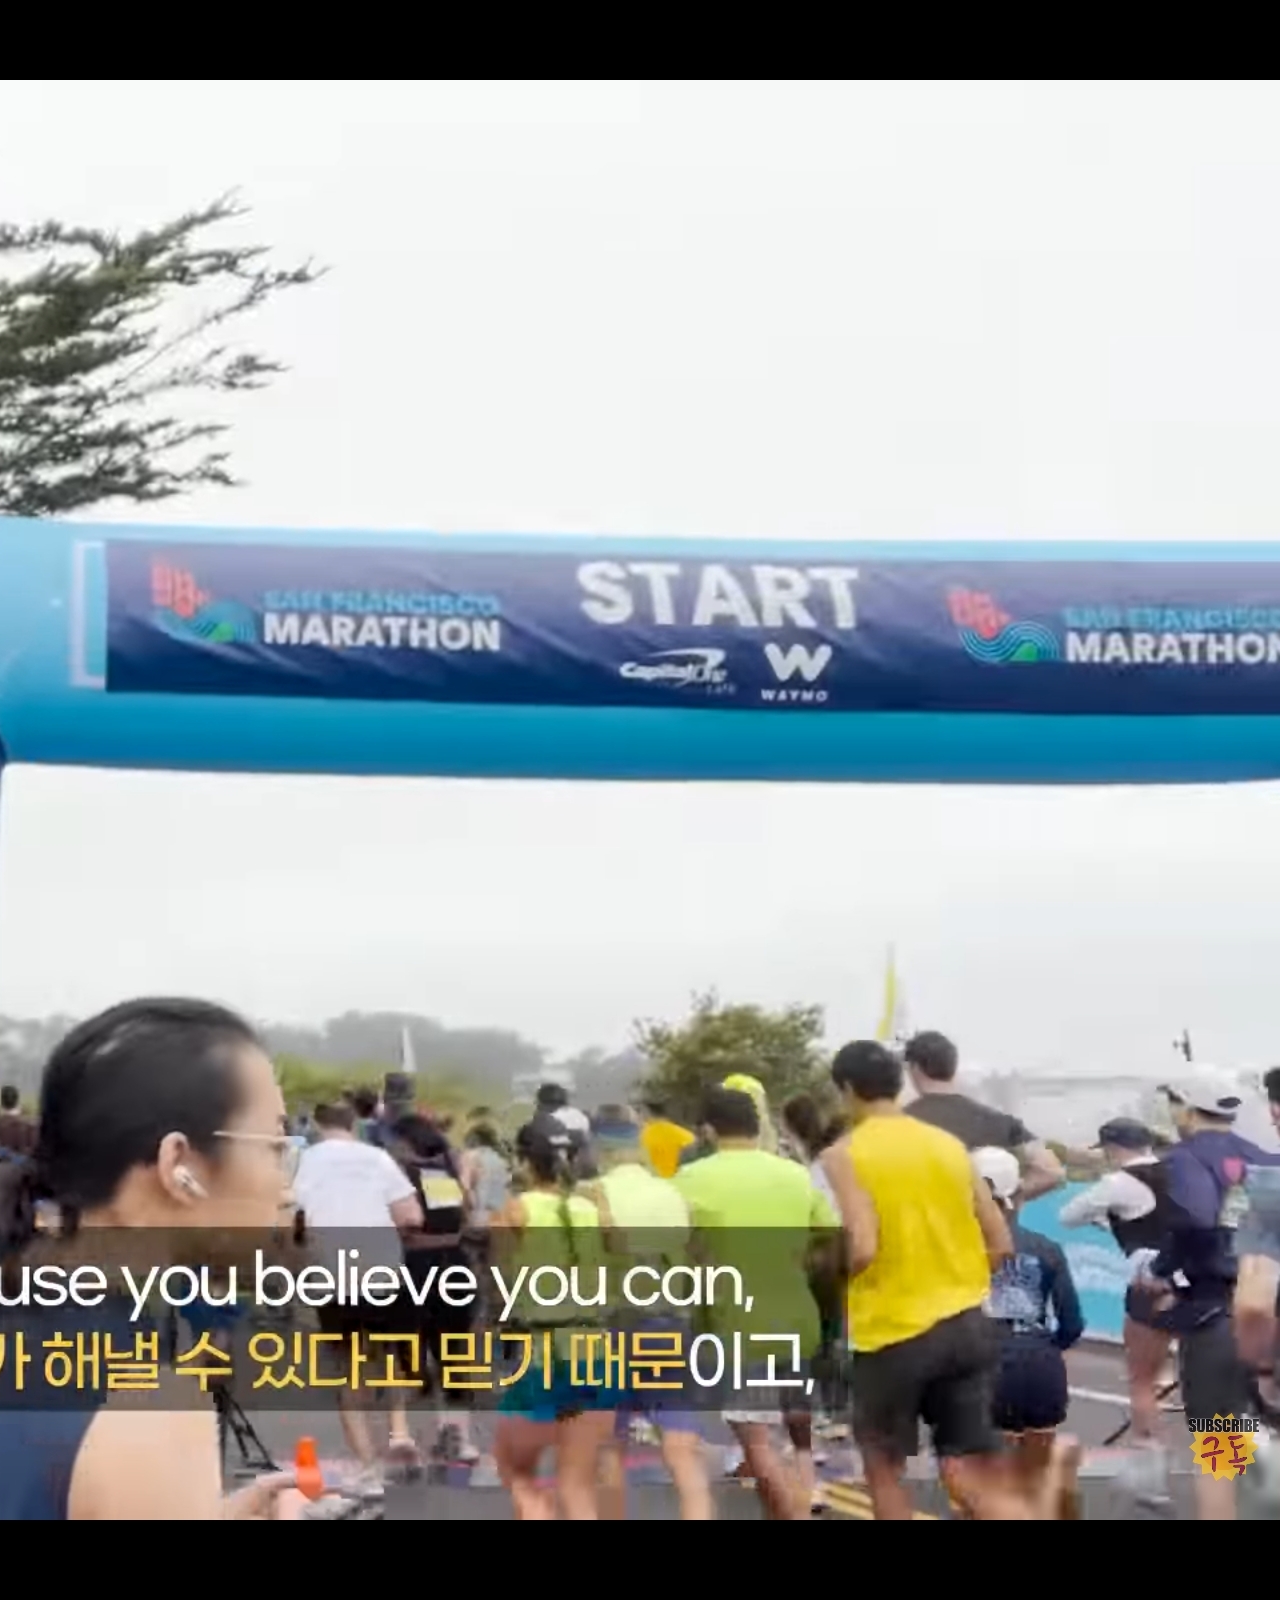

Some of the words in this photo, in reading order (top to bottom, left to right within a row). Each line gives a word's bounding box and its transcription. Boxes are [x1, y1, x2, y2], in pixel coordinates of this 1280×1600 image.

[576, 560, 859, 629] START
[264, 612, 501, 651] MARATHON
[761, 689, 828, 701] WAYMO
